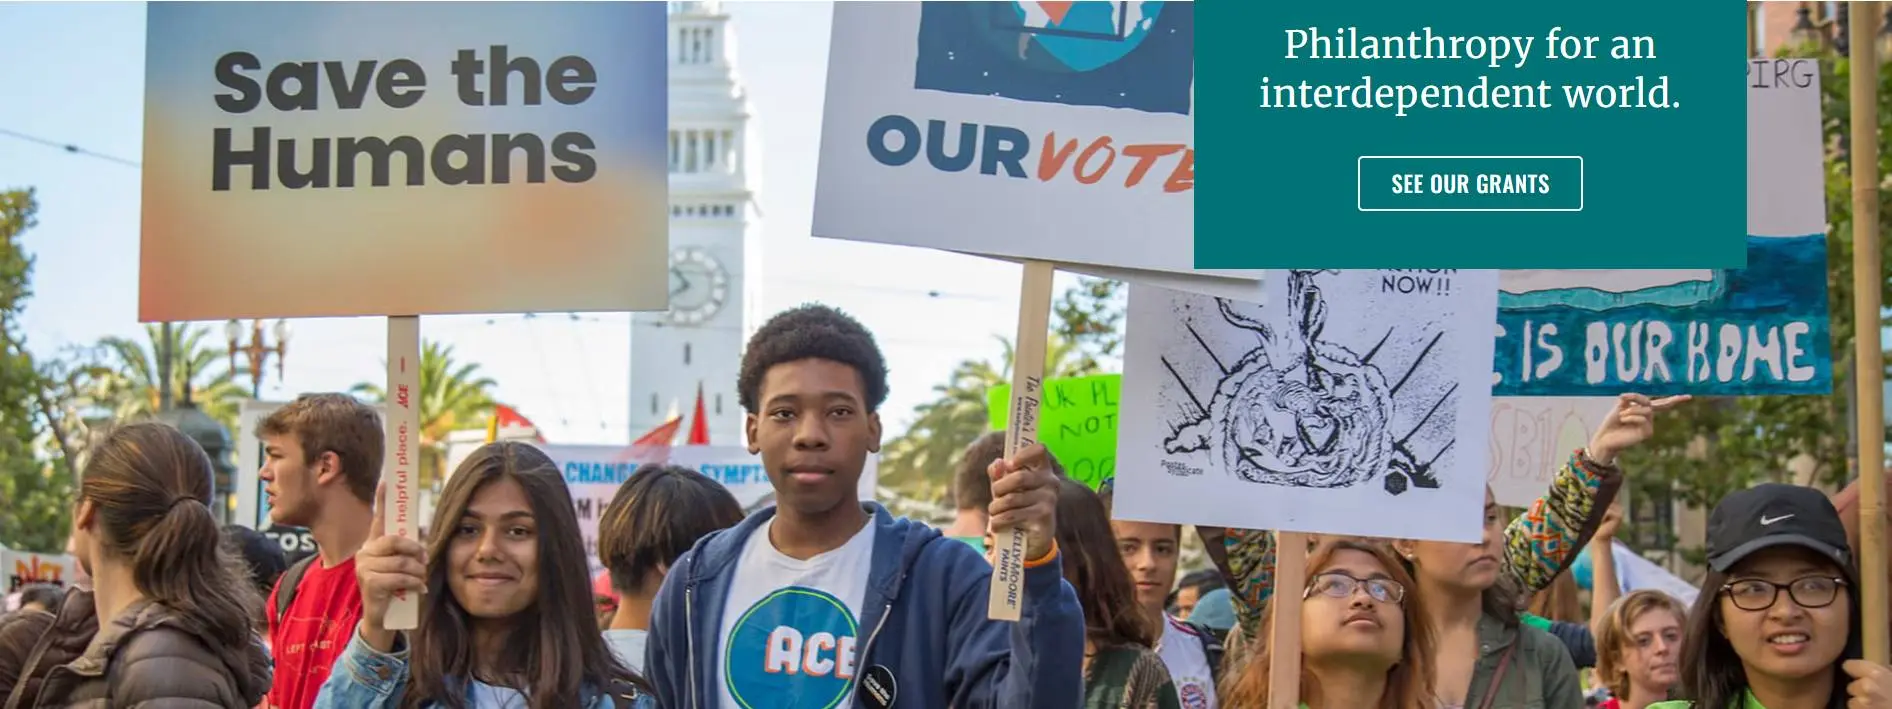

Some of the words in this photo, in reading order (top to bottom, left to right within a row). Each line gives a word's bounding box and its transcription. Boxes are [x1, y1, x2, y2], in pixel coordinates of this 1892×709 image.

[214, 50, 426, 113] Save
[450, 45, 597, 106] the
[1746, 58, 1814, 89] IRG
[211, 127, 597, 191] Humans
[866, 114, 1030, 179] OUR
[1382, 275, 1450, 296] NOW!!
[1521, 320, 1563, 382] IS
[1585, 320, 1672, 384] OUR
[1687, 321, 1815, 382] HOME
[1060, 413, 1117, 440] NOT
[764, 625, 858, 679] ACE
